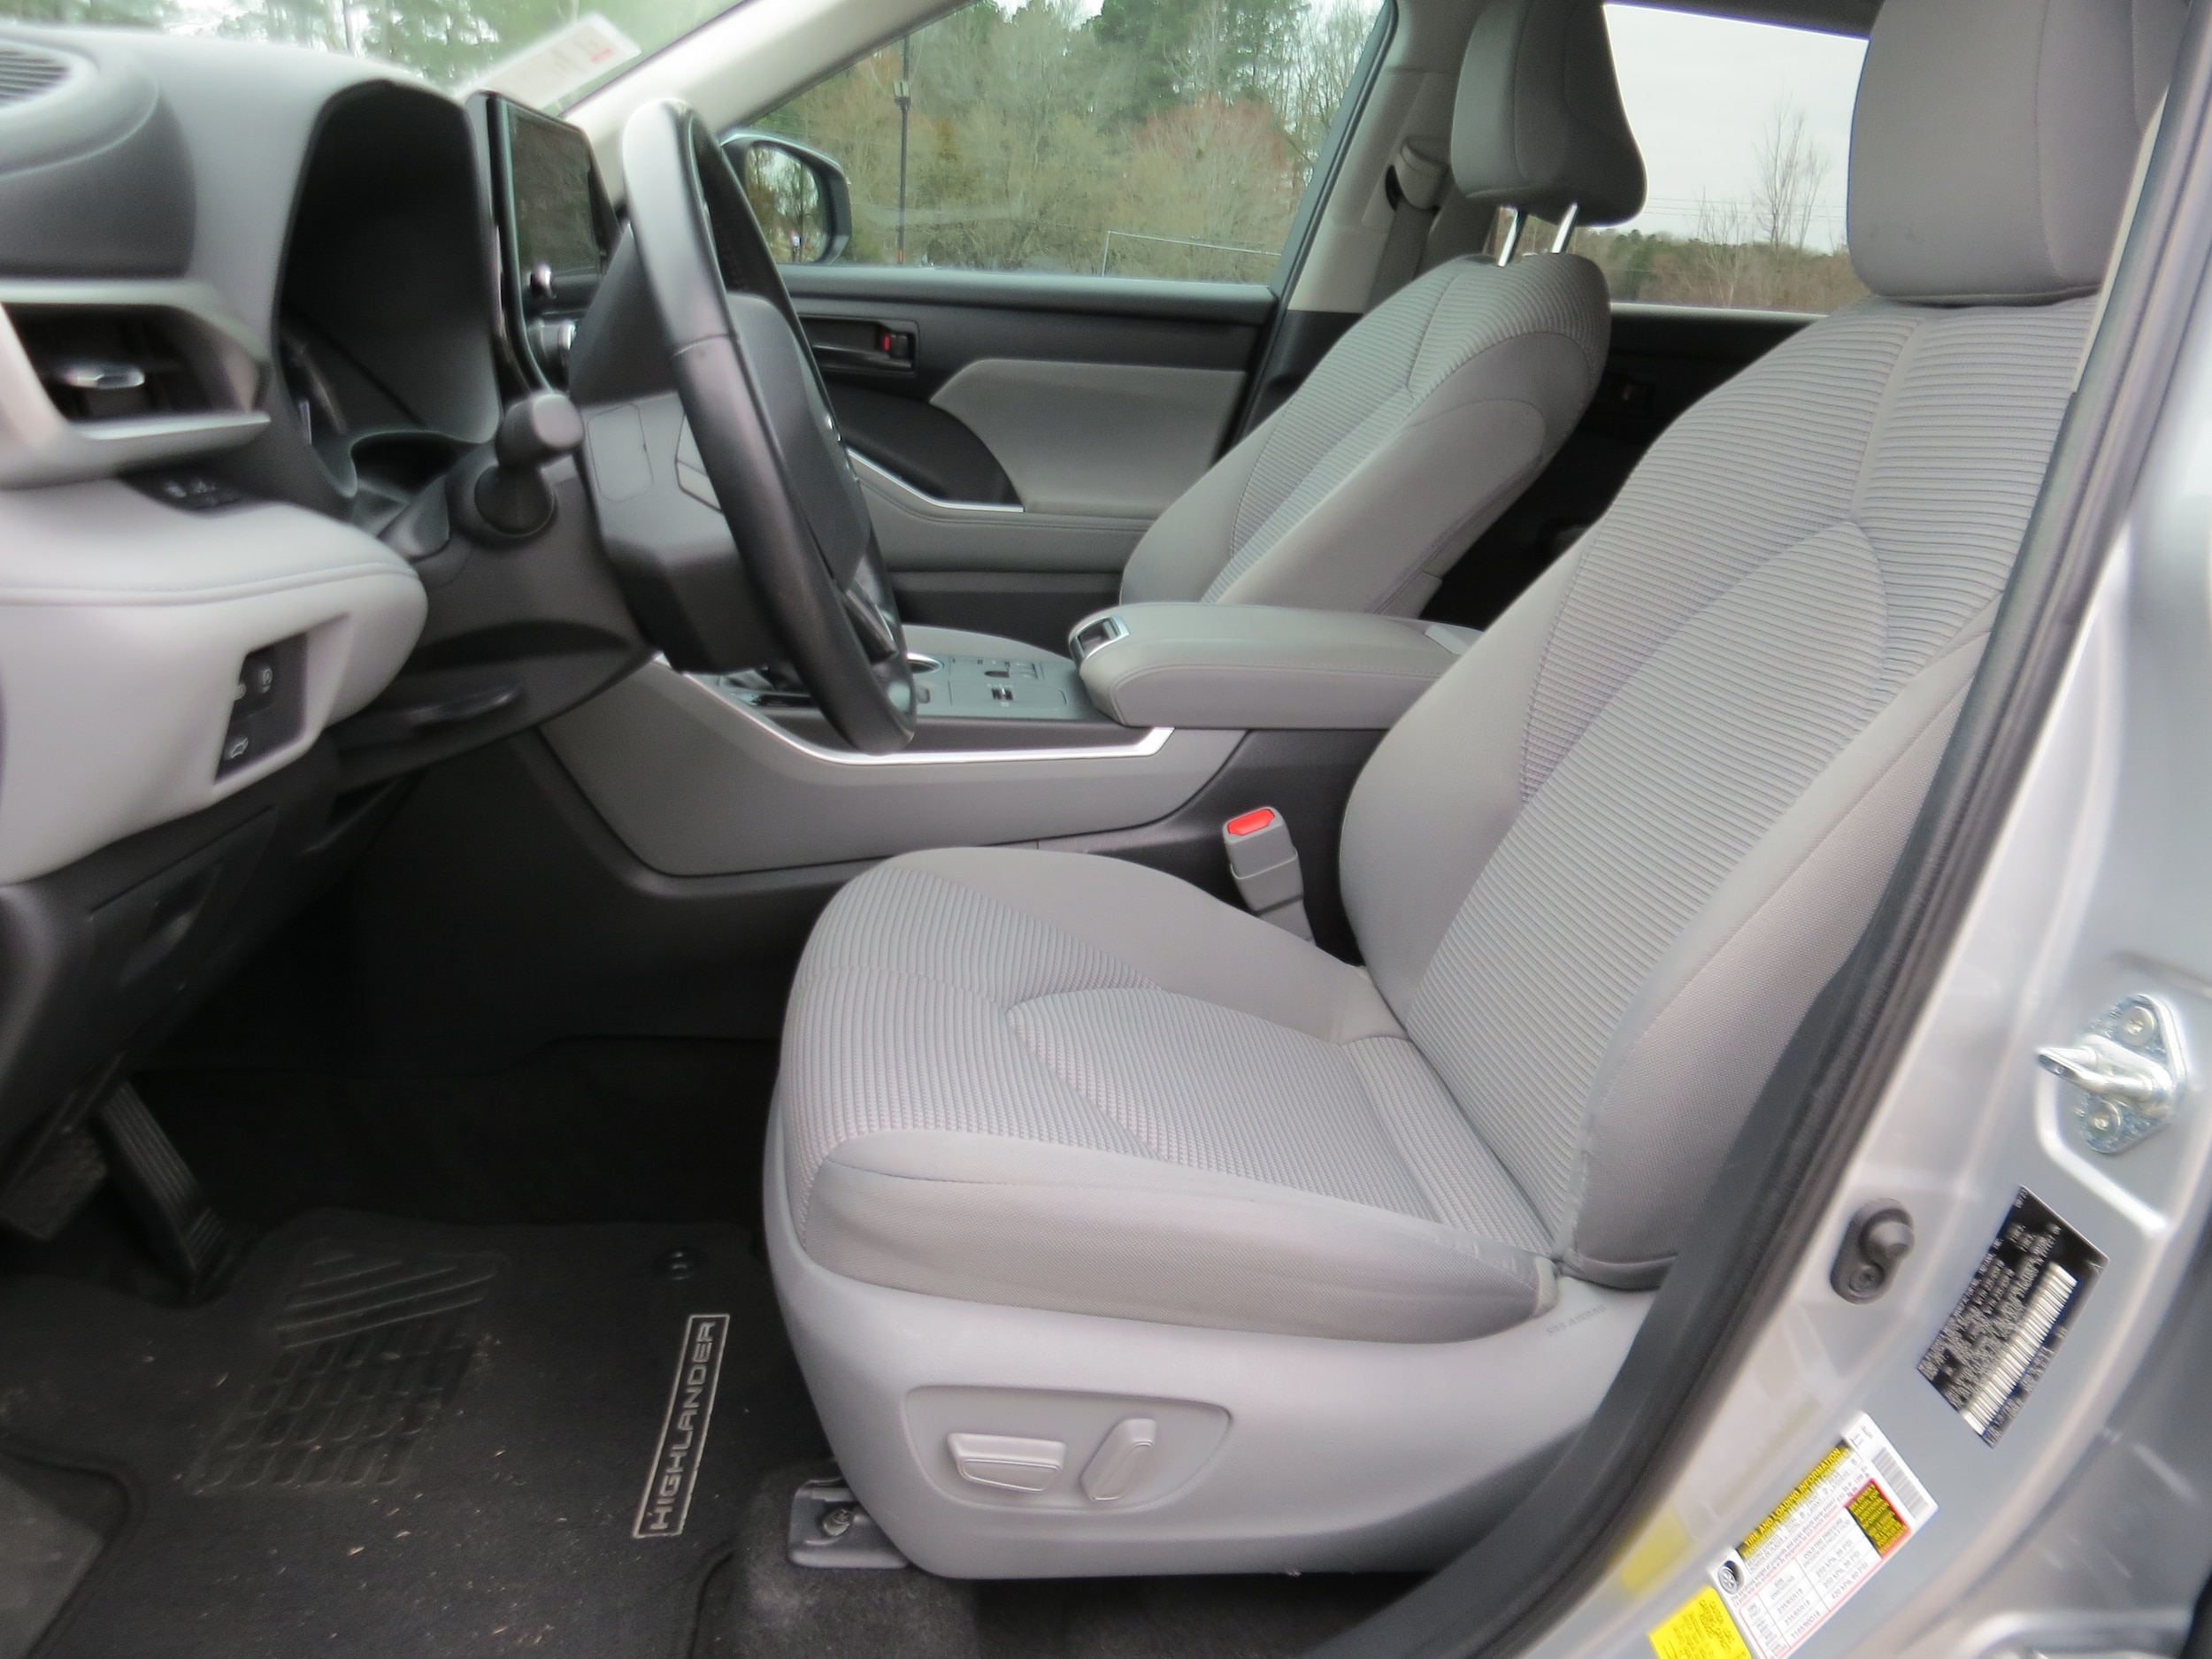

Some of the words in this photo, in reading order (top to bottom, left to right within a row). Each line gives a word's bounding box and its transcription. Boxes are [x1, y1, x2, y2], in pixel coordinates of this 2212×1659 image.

[649, 1321, 717, 1531] HIGHLANDER
[1743, 1529, 1759, 1548] TIRE
[1757, 1515, 1774, 1533] AND
[1770, 1487, 1801, 1520] LOADING
[1796, 1447, 1841, 1494] INFORMATION
